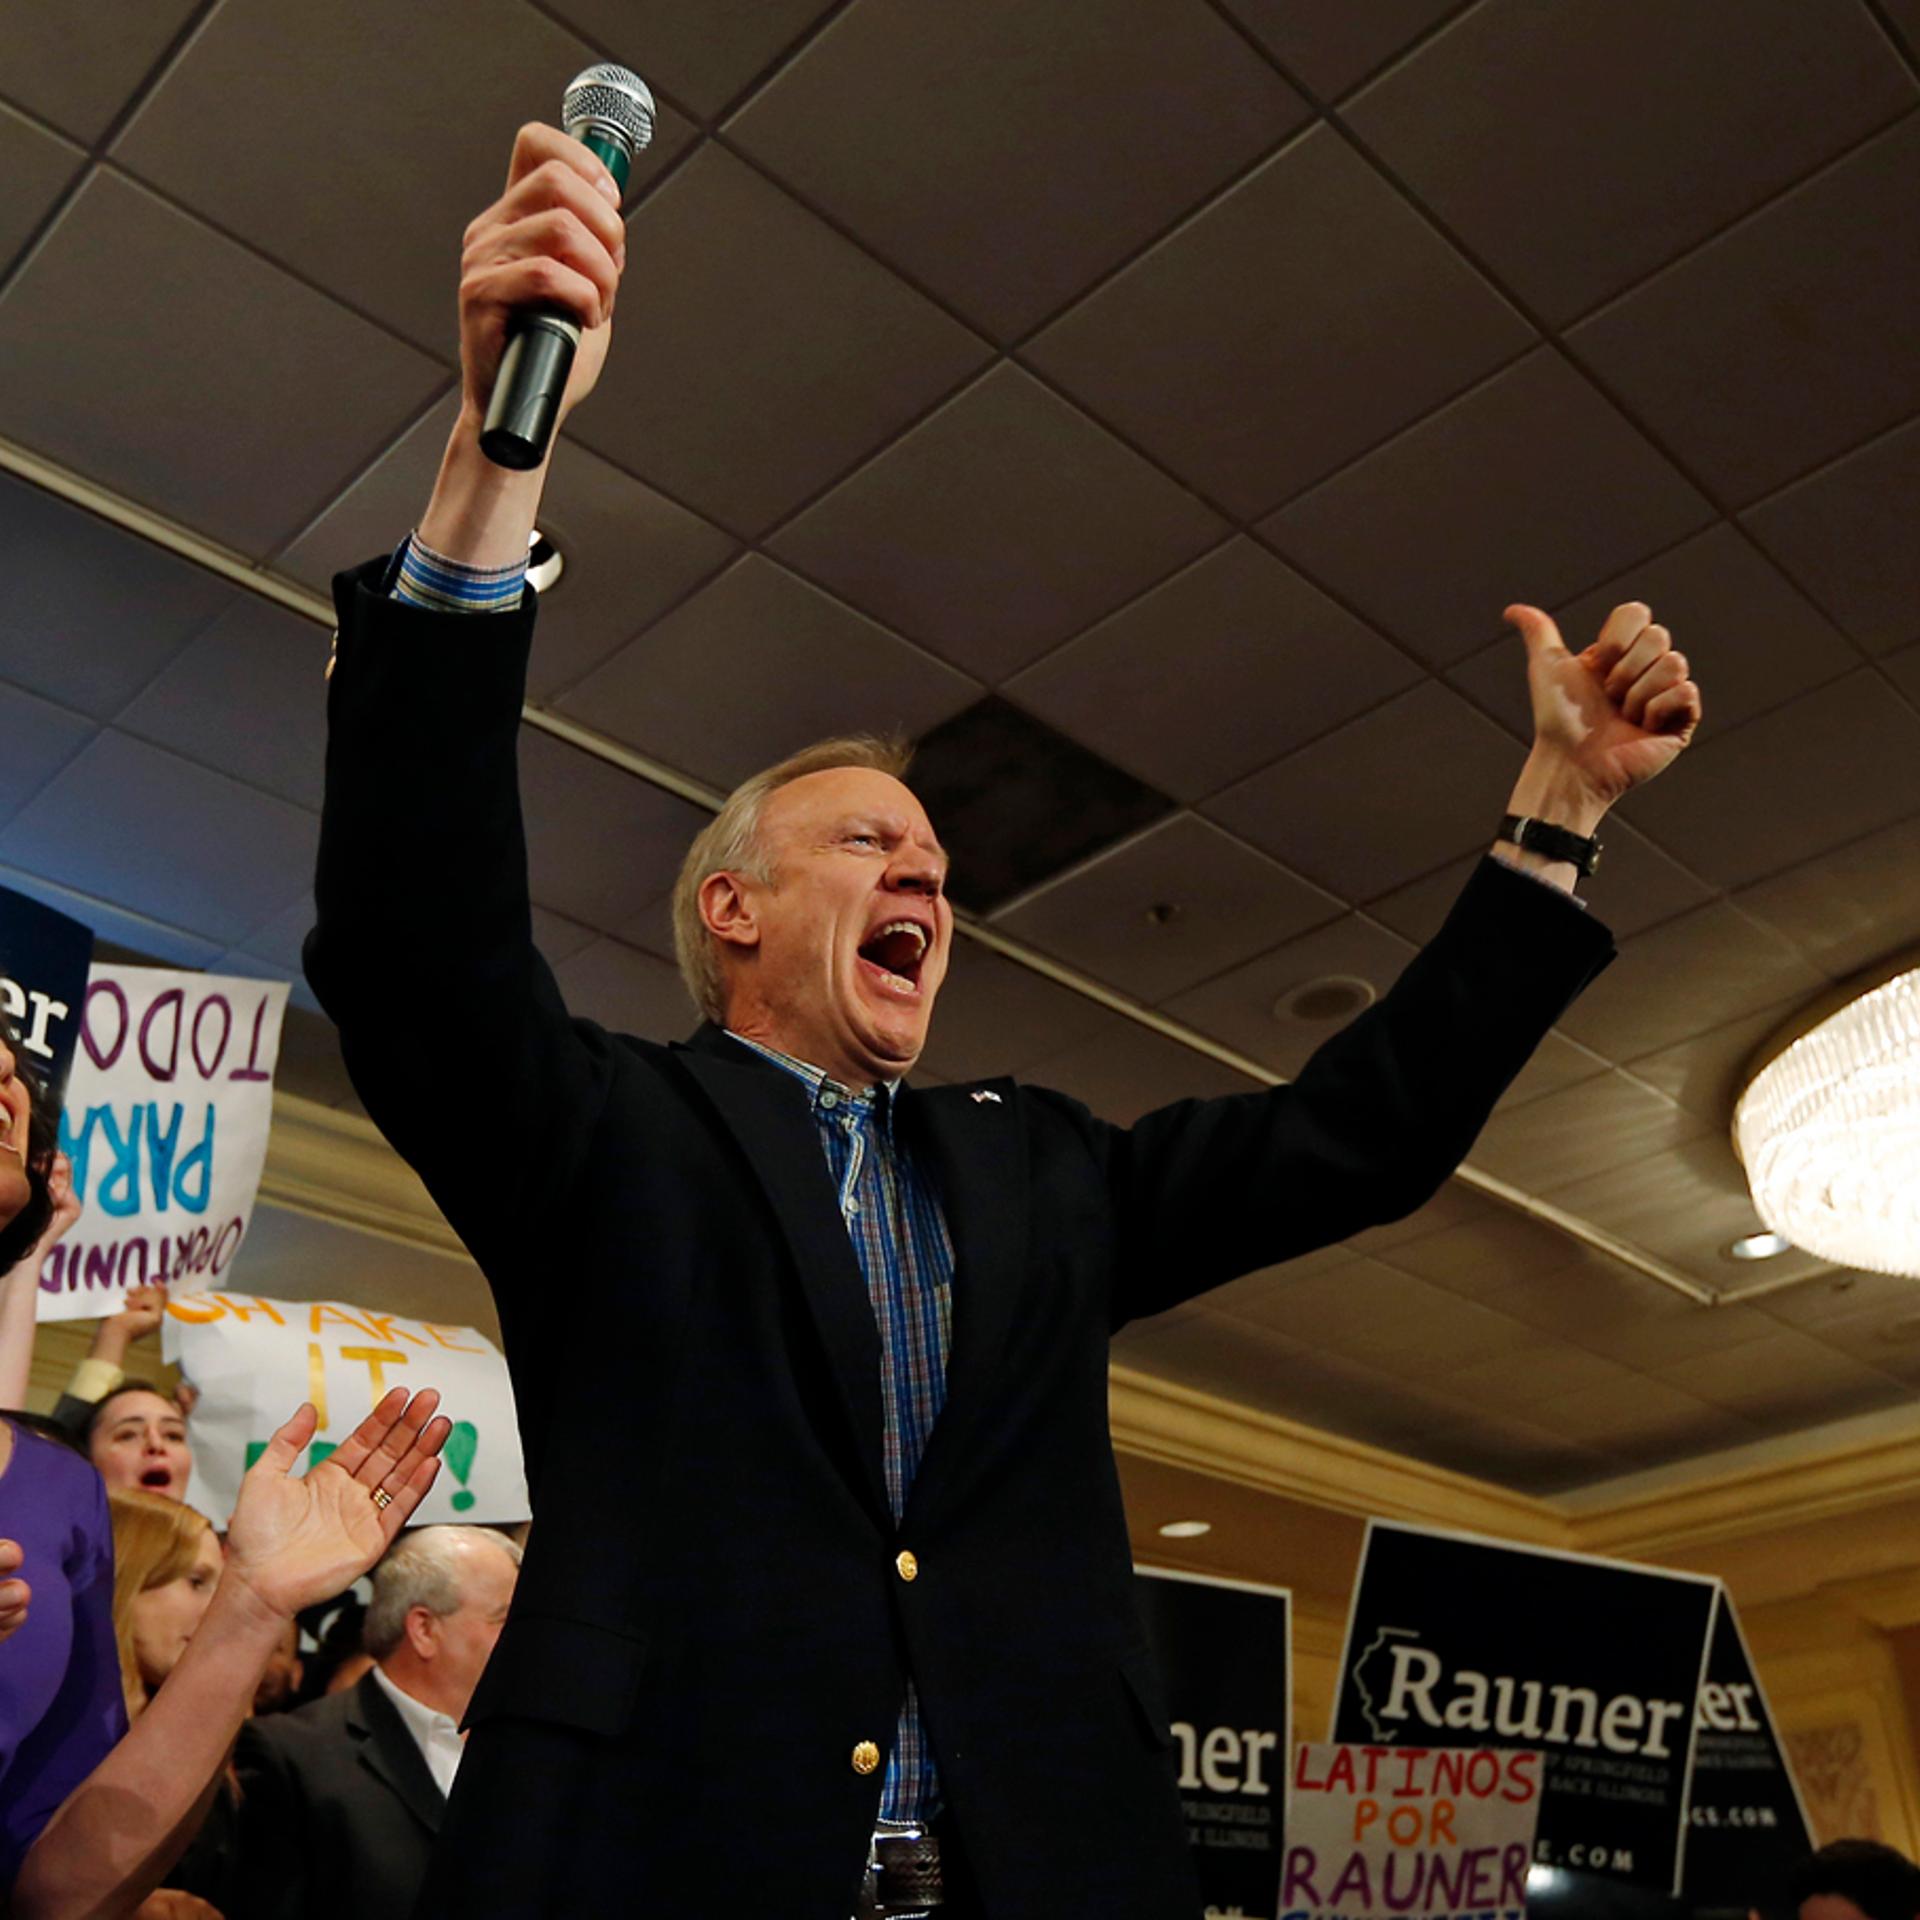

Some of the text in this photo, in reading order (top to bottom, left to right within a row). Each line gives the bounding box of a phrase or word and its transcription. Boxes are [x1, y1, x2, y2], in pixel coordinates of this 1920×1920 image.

[1379, 1644, 1683, 1758] Rauner
[1696, 1681, 1760, 1731] er
[1297, 1746, 1536, 1803] LATINOS
[1354, 1800, 1457, 1846] POR
[1283, 1843, 1527, 1911] RAUNER
